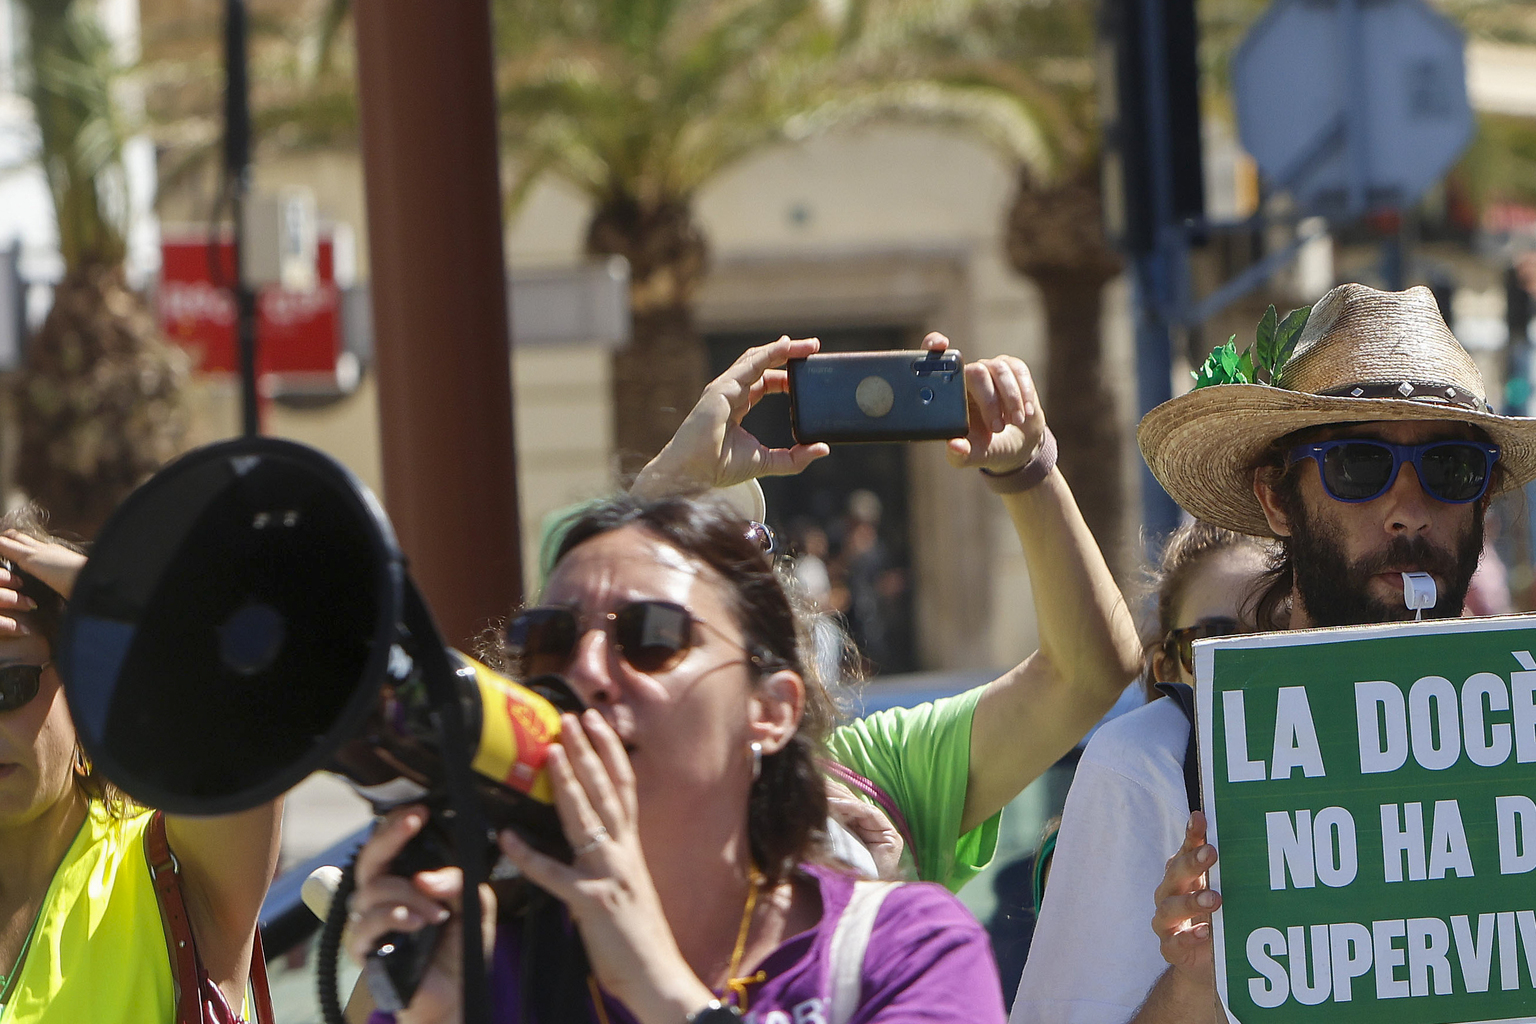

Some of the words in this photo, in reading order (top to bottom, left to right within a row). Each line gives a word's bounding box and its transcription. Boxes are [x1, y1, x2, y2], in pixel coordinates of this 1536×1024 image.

[1221, 685, 1326, 783] LA
[1265, 806, 1360, 890] NO
[1379, 799, 1475, 883] HA
